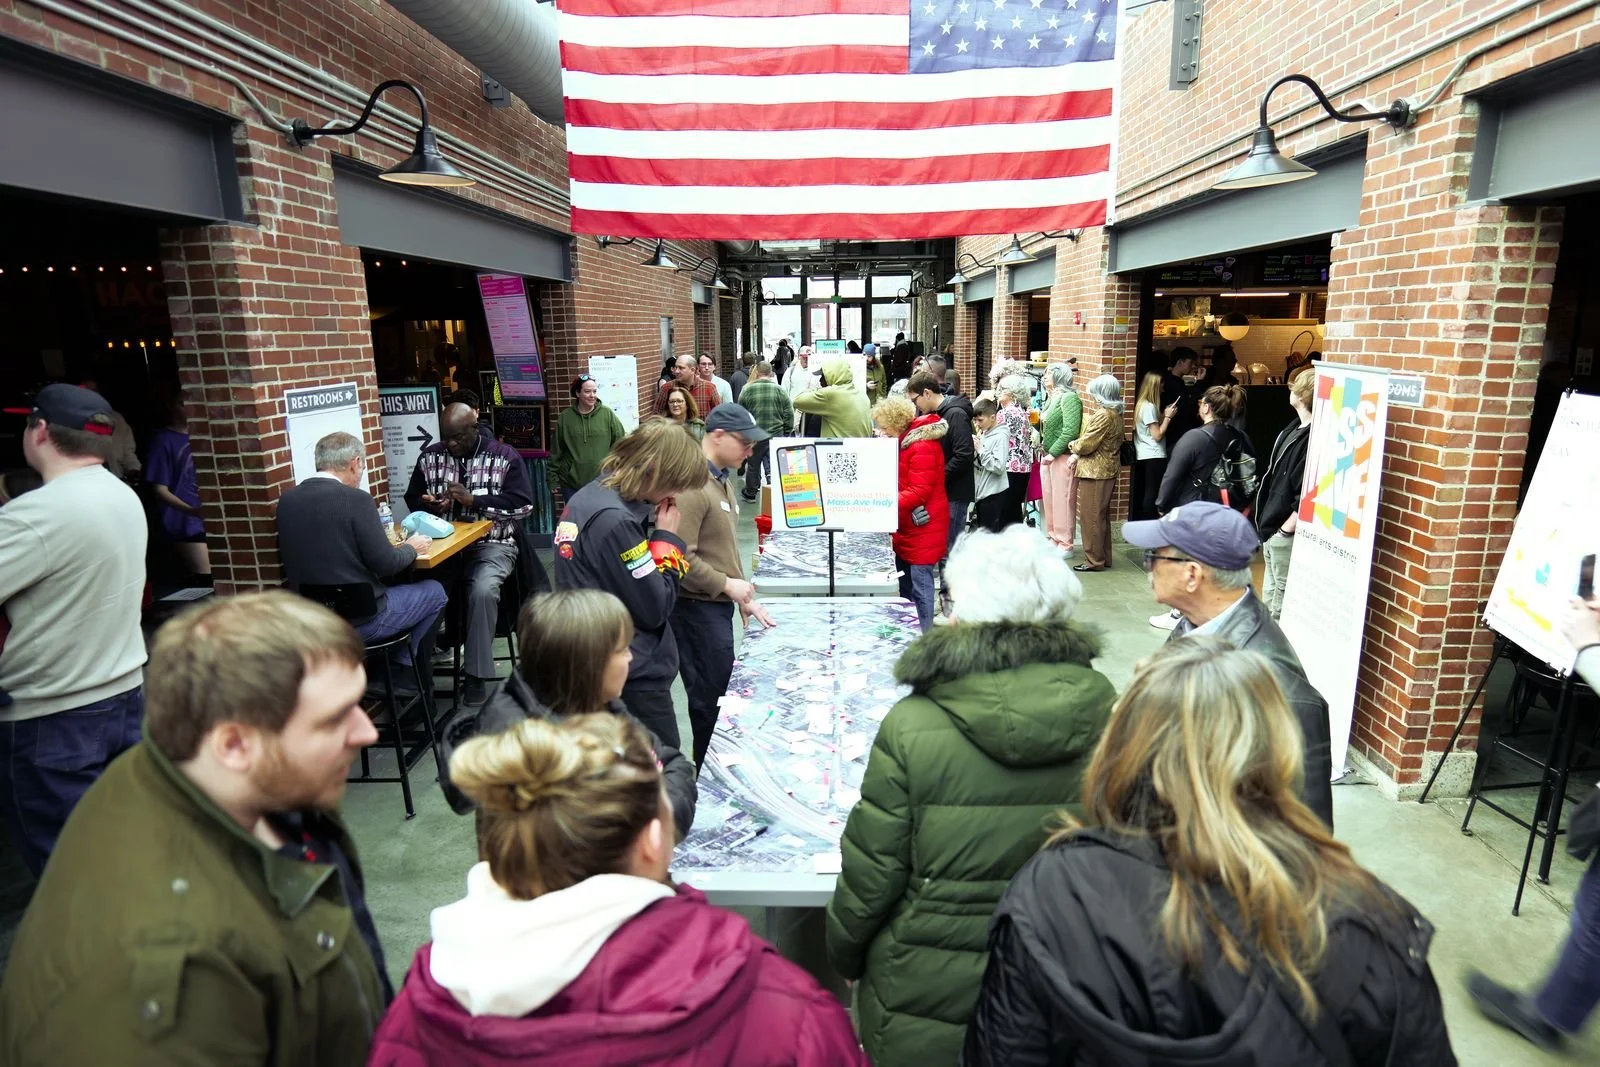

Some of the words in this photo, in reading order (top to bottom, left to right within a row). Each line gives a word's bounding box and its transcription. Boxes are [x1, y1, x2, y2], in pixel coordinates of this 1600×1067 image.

[291, 391, 344, 409] RESTROOMS
[380, 396, 402, 413] THIS
[404, 394, 430, 412] WAY
[872, 498, 893, 508] Indy
[1319, 537, 1332, 551] arts
[1333, 545, 1358, 565] district
